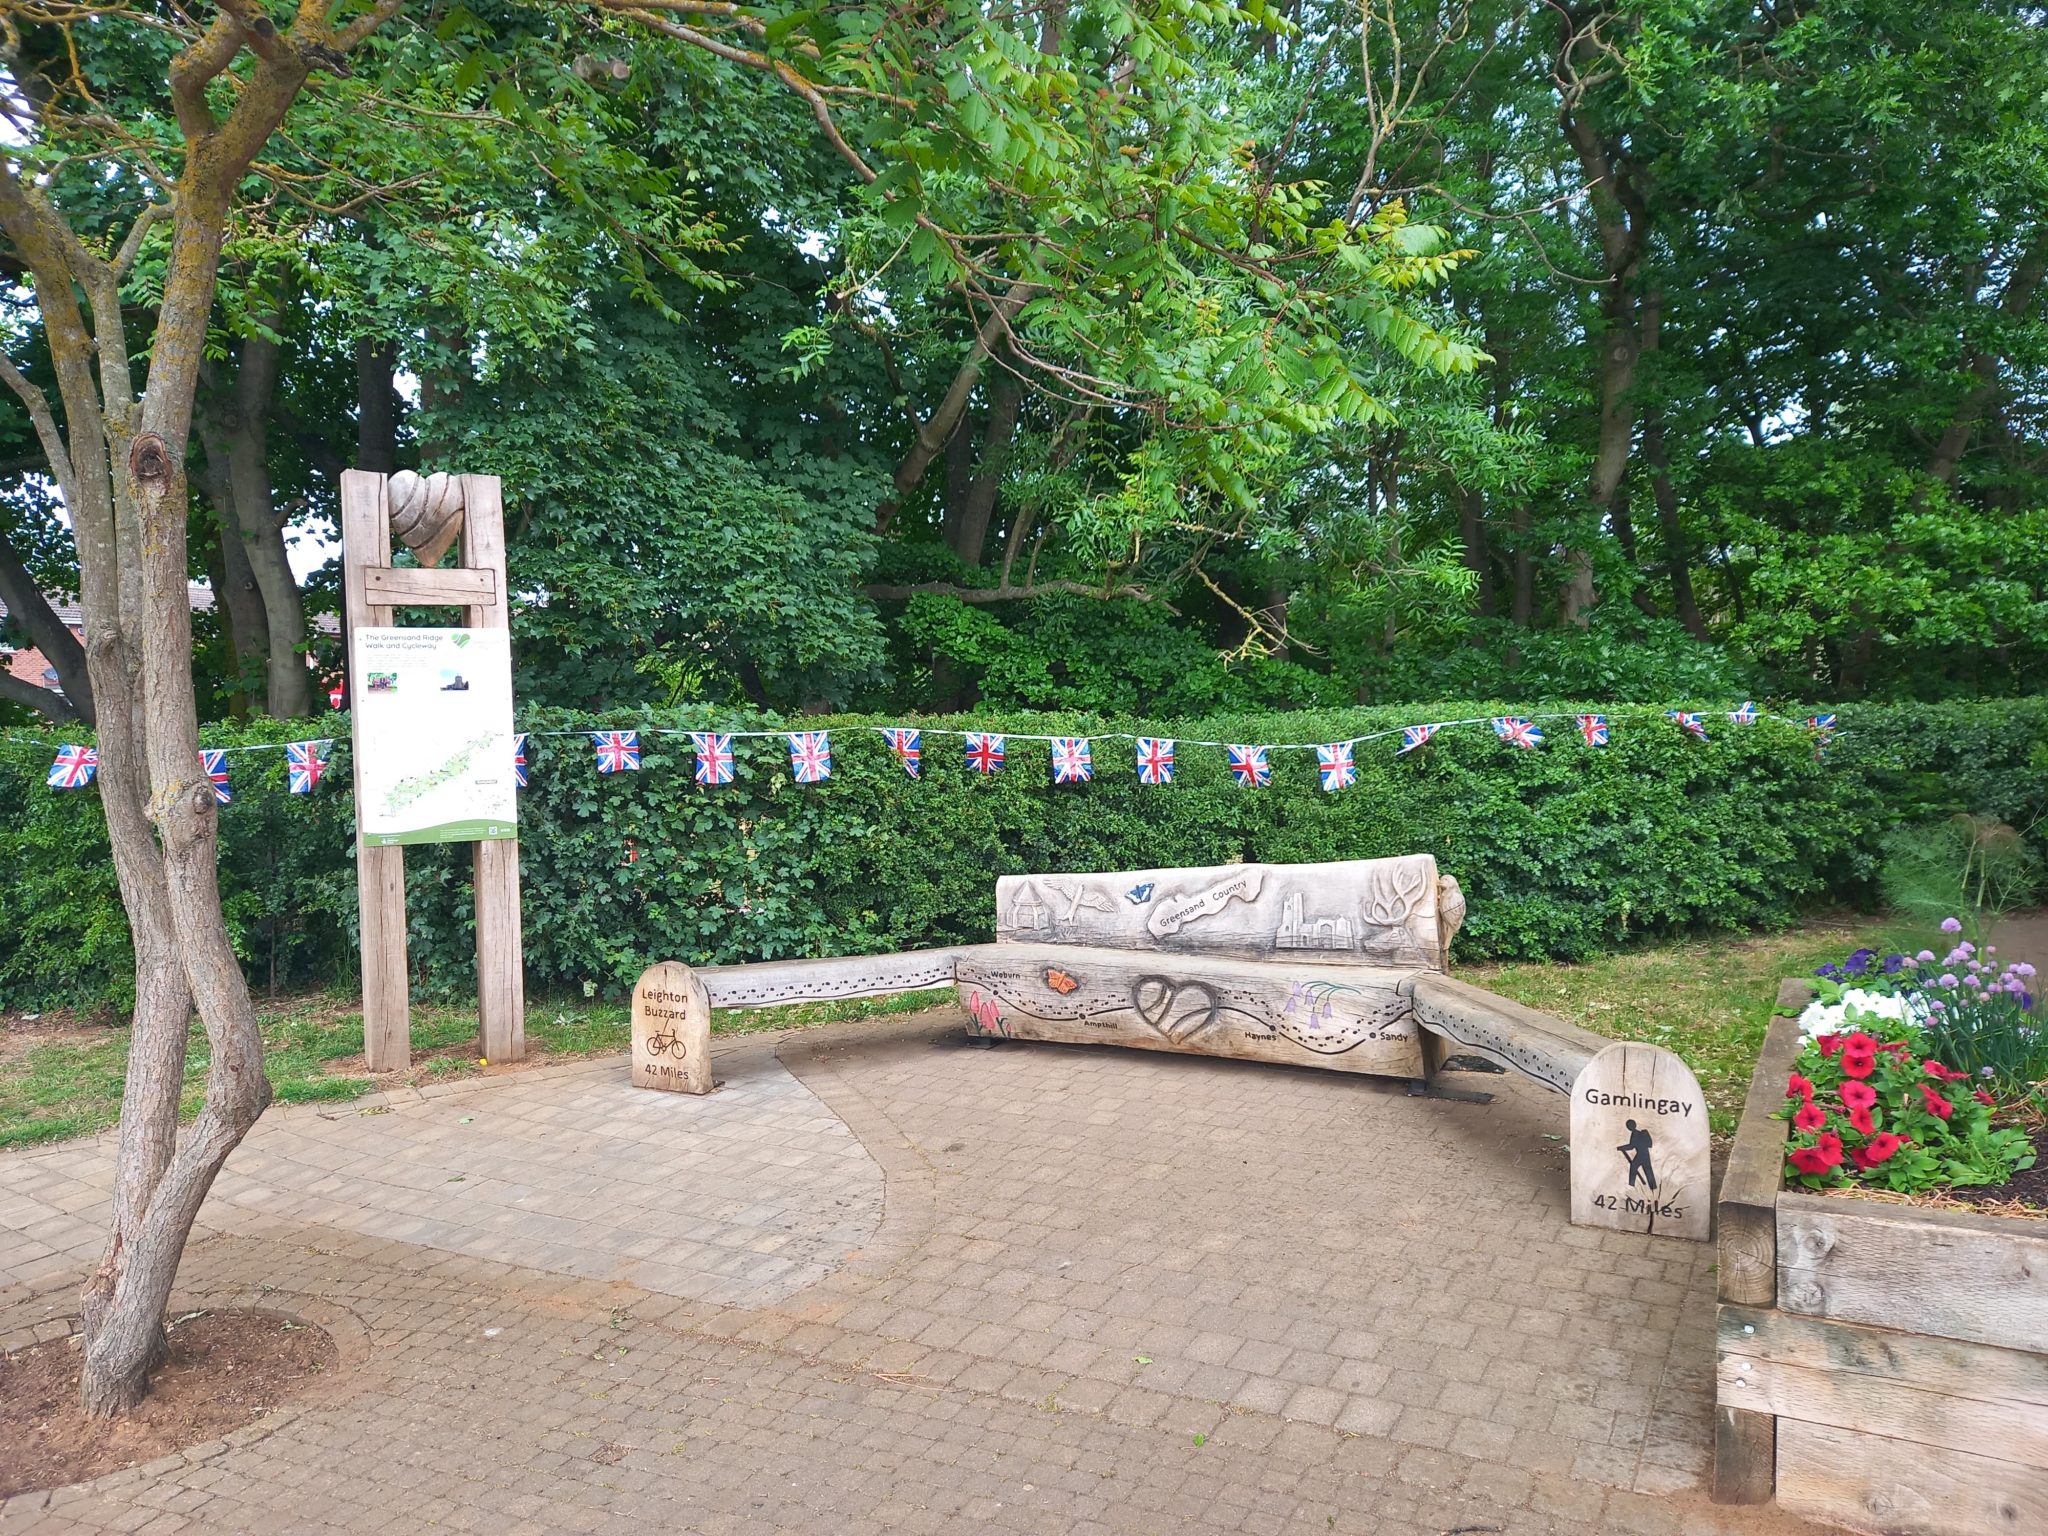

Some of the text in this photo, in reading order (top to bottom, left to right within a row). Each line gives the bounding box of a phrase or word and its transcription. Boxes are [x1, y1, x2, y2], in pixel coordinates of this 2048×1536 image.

[422, 634, 444, 642] Ridge
[401, 642, 437, 650] Cycleway
[1159, 880, 1247, 927] Greensand Country
[990, 970, 1021, 979] Woburn
[642, 988, 688, 1003] Leighton
[644, 1005, 686, 1020] Buzzard
[1084, 1020, 1118, 1030] Ampthill
[1244, 1031, 1277, 1041] Haynes
[1380, 1032, 1408, 1042] Sandy
[645, 1063, 689, 1080] 42 Miles
[1585, 1088, 1693, 1117] Gamlingay
[1594, 1194, 1683, 1219] 42 Miles
